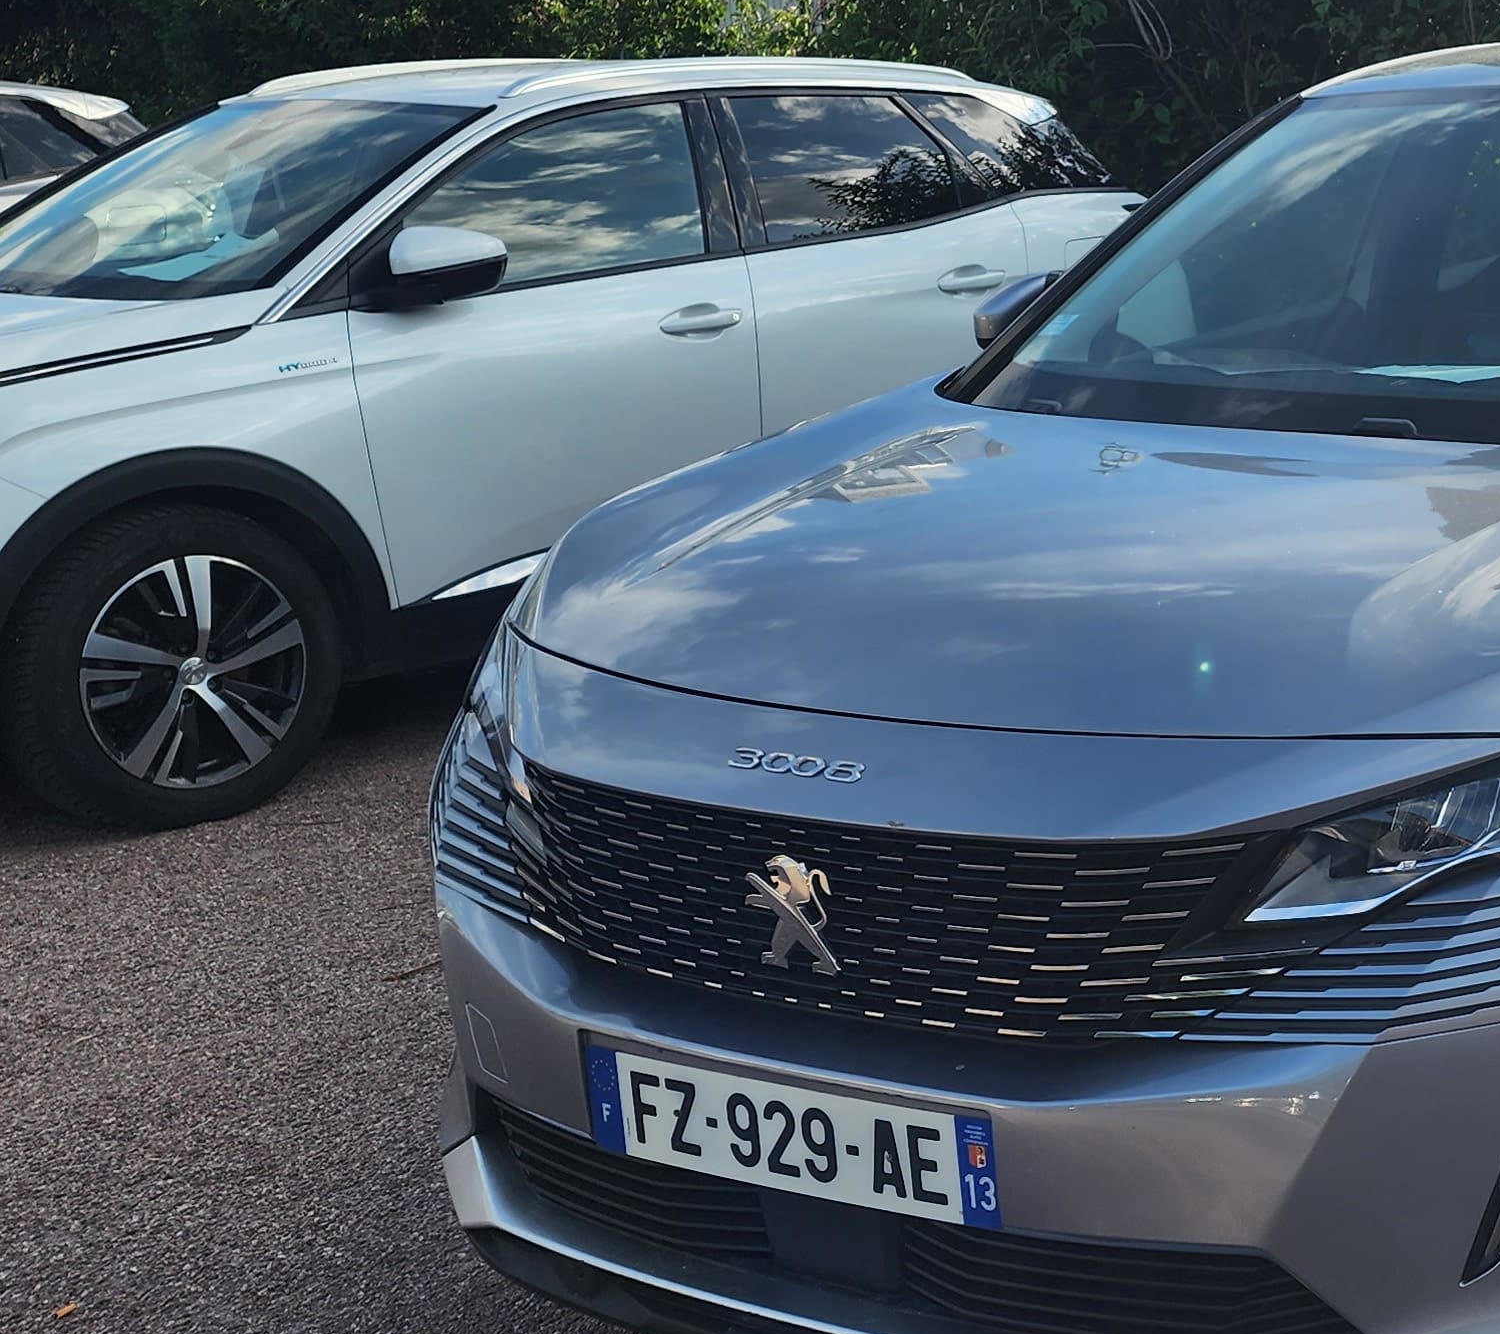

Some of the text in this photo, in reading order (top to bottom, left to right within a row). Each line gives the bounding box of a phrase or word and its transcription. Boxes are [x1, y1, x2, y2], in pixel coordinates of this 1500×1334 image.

[727, 747, 866, 784] 3008
[601, 1102, 612, 1123] F
[629, 1070, 949, 1206] FZ-929-AE
[964, 1173, 997, 1212] 13
